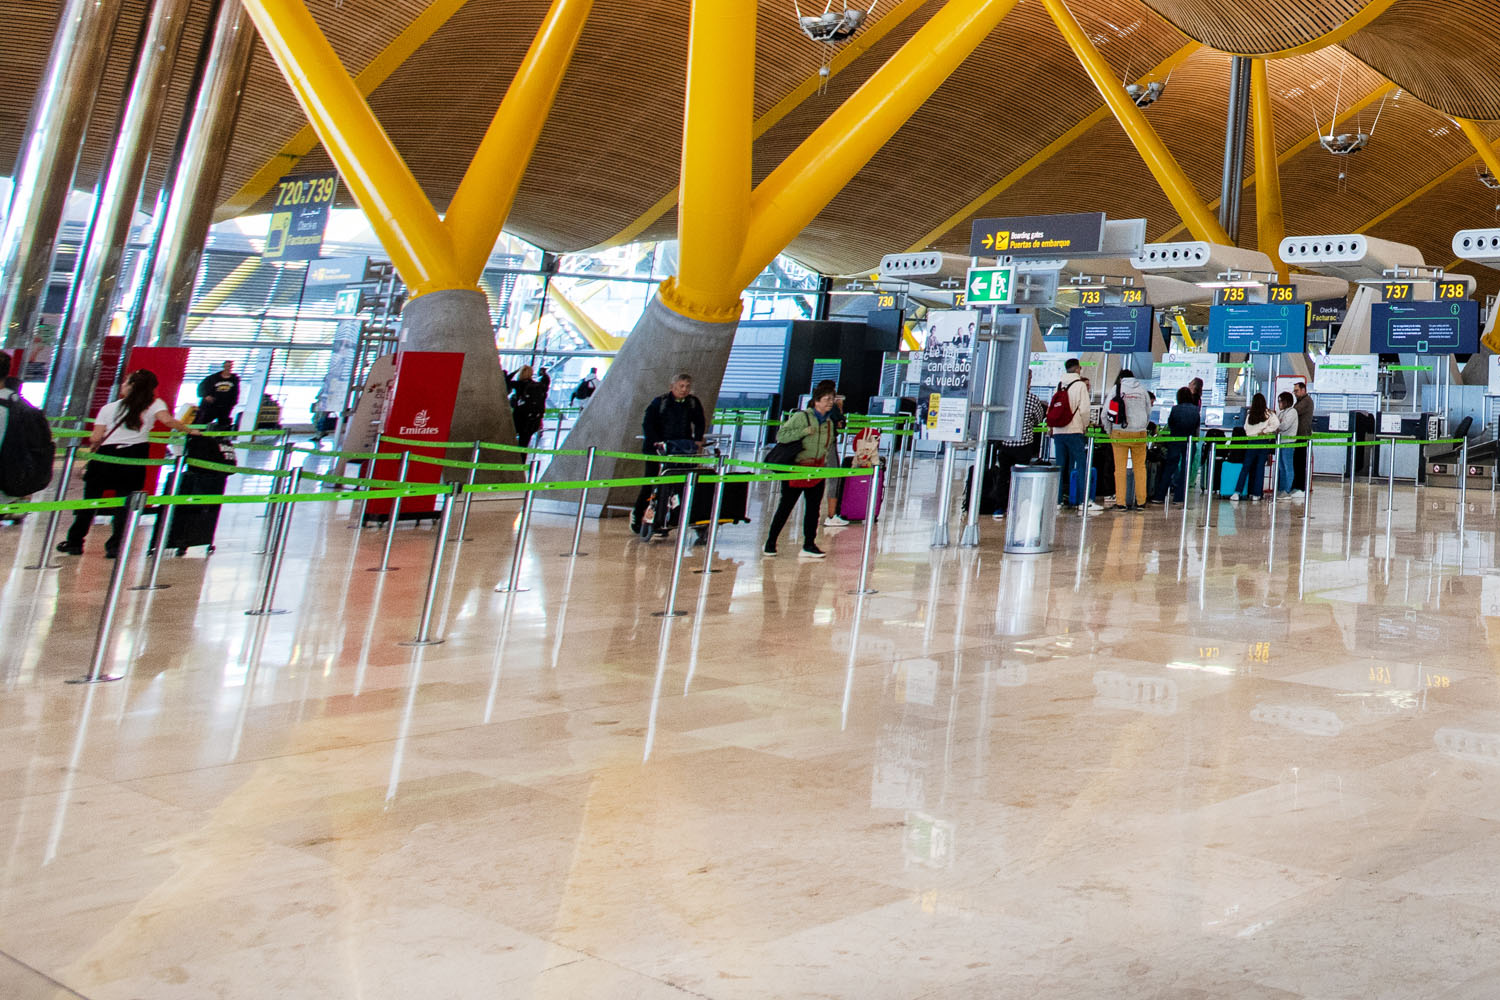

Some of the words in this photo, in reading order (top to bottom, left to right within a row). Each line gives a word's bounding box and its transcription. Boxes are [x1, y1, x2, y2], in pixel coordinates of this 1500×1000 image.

[275, 181, 303, 206] 720
[305, 178, 334, 204] 739
[1010, 232, 1031, 240] Boarding
[1031, 232, 1044, 240] gates
[1010, 240, 1032, 249] Puertas
[1033, 240, 1040, 248] de
[1041, 239, 1071, 249] embarque
[1122, 290, 1142, 303] 734
[1223, 288, 1245, 301] 735
[1271, 287, 1293, 301] 736
[1385, 284, 1409, 299] 737
[1439, 283, 1464, 298] 738
[878, 295, 894, 307] 730
[955, 294, 965, 307] 73
[1081, 291, 1100, 304] 733
[1320, 306, 1338, 314] Check-in
[1312, 314, 1337, 322] Facturac
[927, 361, 972, 372] cancelado
[925, 374, 935, 386] el
[936, 374, 966, 387] vuelo?
[399, 426, 440, 435] Emirates
